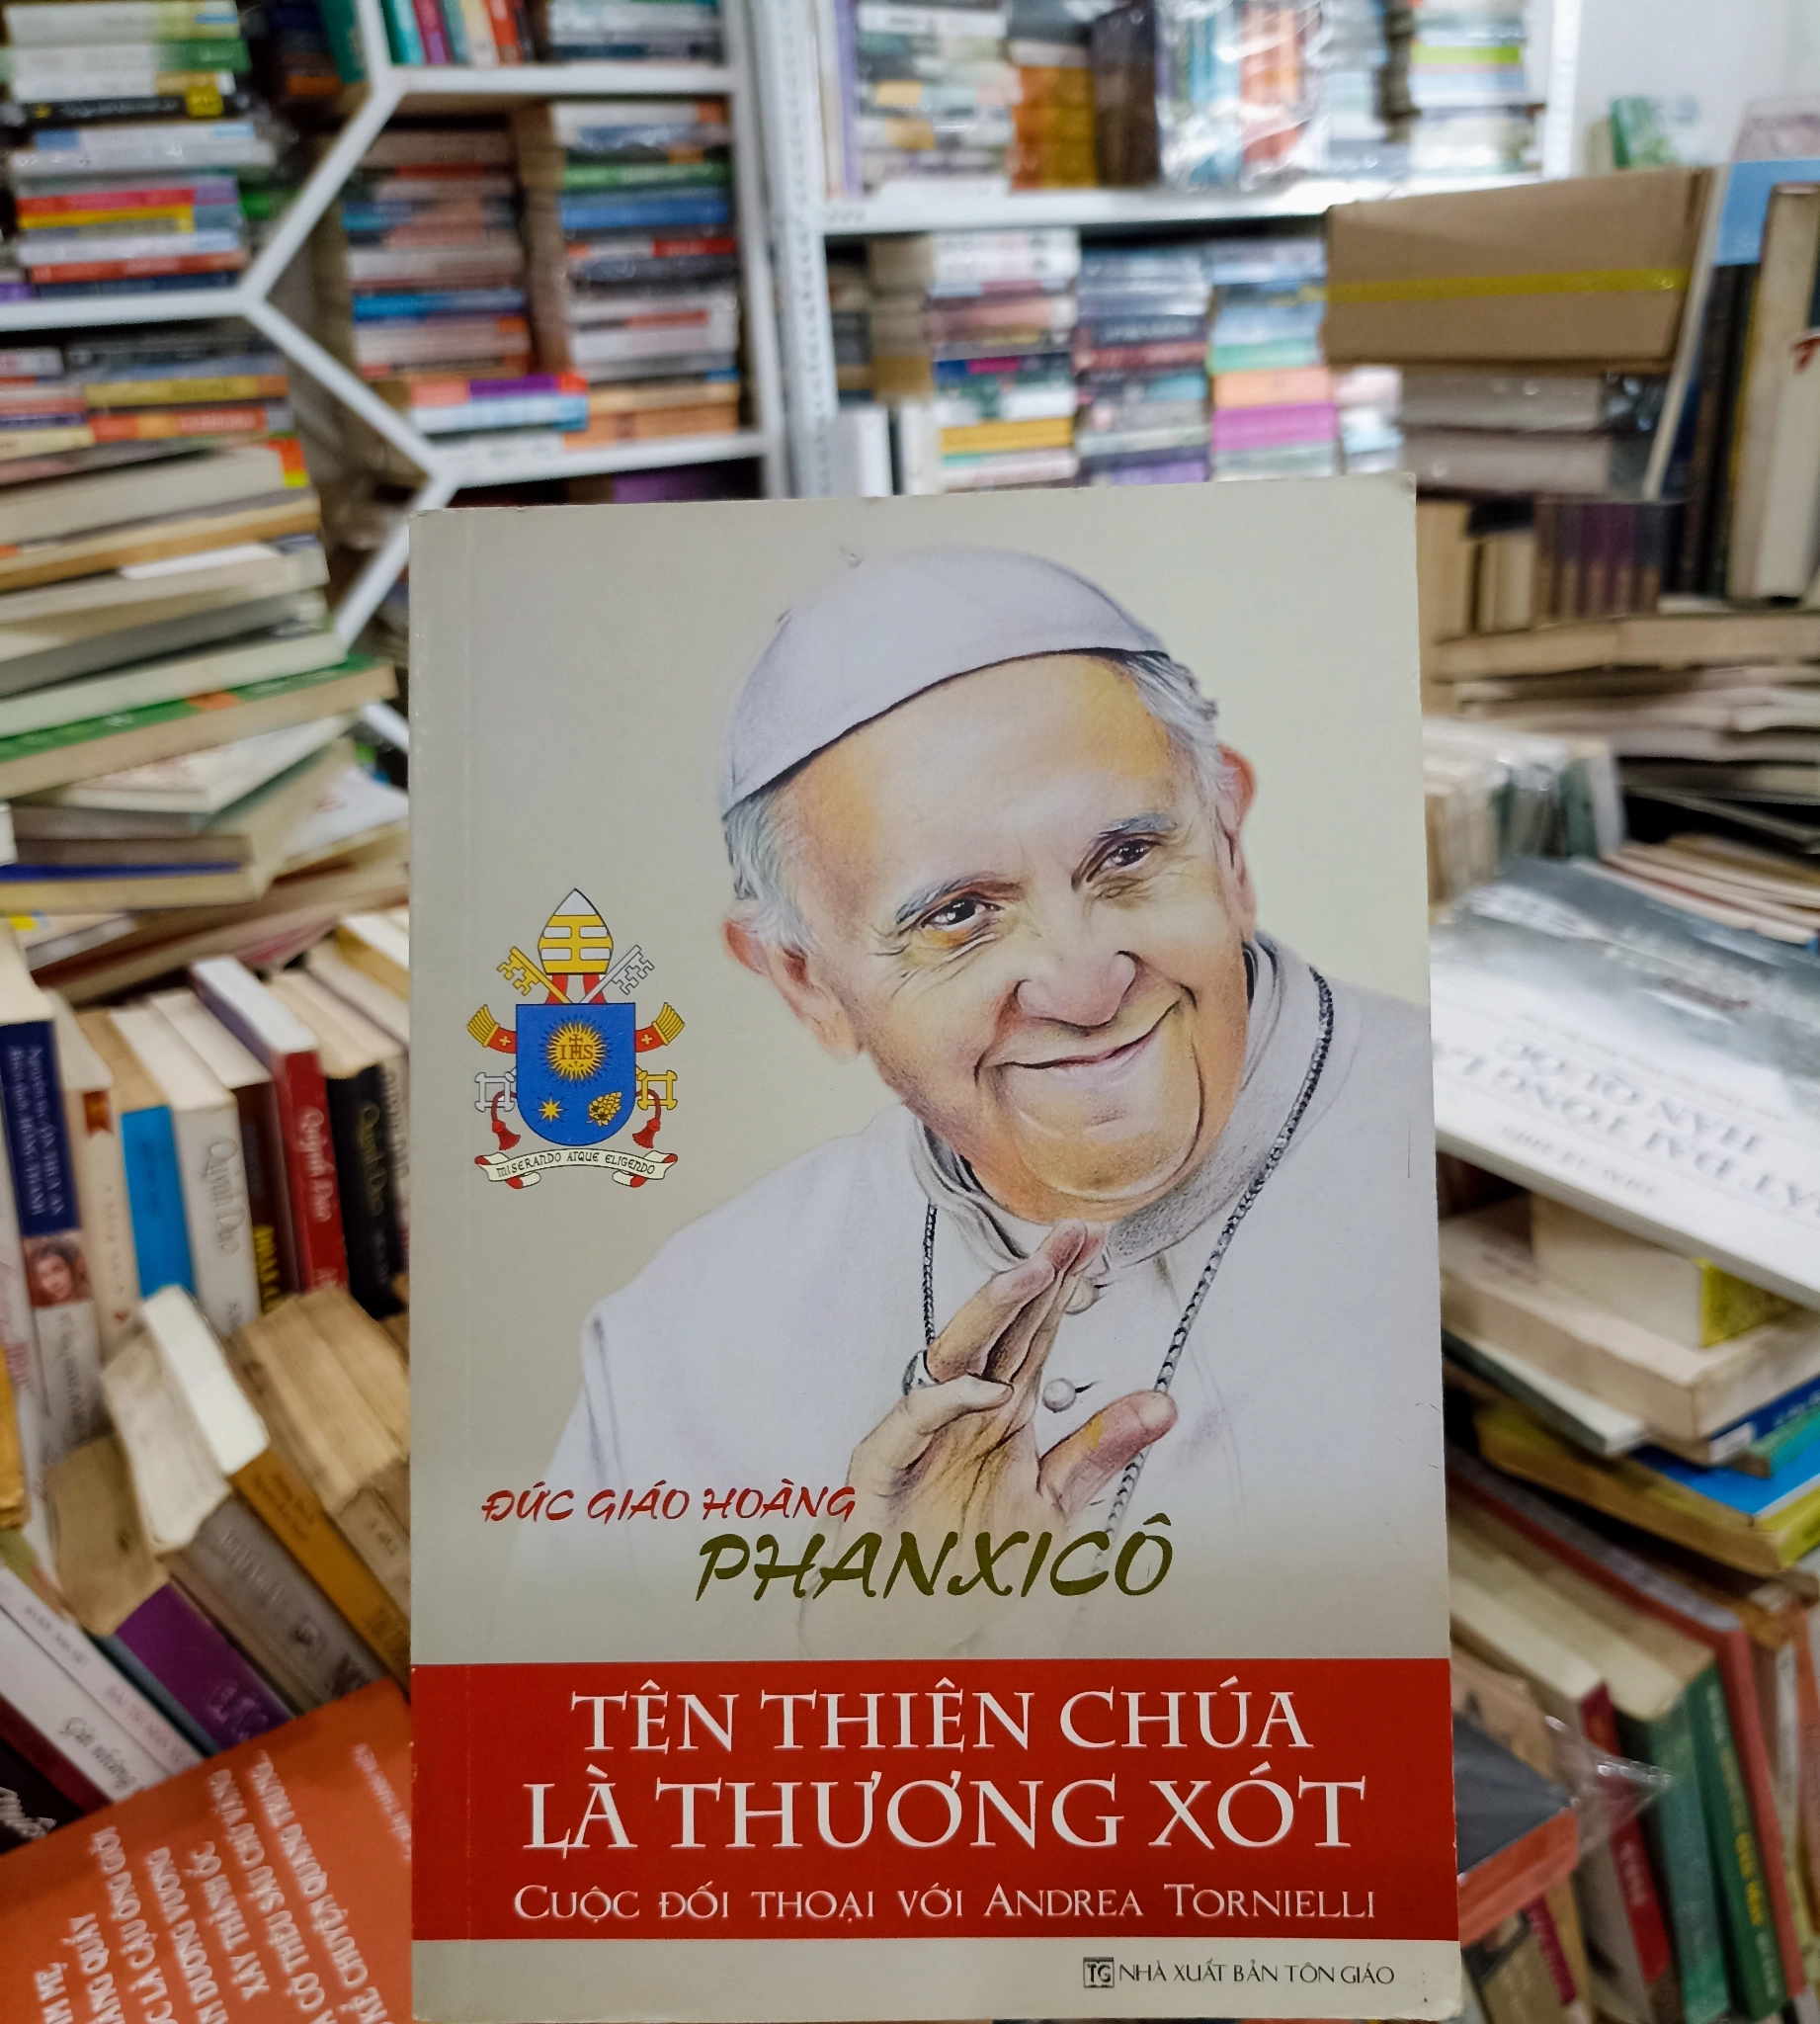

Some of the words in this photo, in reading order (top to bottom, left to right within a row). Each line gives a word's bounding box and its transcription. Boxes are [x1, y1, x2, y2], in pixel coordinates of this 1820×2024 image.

[496, 1152, 562, 1178] MISERANDO
[566, 1150, 600, 1163] ATQUE
[605, 1154, 656, 1175] ELIGENDO
[482, 1482, 573, 1521] ĐỨC
[588, 1480, 689, 1522] GIÁO
[703, 1479, 856, 1521] HOÀNG
[697, 1510, 1174, 1601] PHANXICÔ
[570, 1679, 739, 1754] TÊN
[761, 1677, 1034, 1752] THIÊN
[1060, 1676, 1314, 1748] CHÚA
[523, 1764, 638, 1859] LÀ
[656, 1770, 1124, 1848] THƯƠNG
[1148, 1761, 1366, 1849] XÓT
[280, 1823, 327, 1898] QUANG
[120, 1918, 158, 1970] CẬU
[1119, 1960, 1167, 1982] NHÀ
[1173, 1958, 1227, 1982] XUẤT
[1233, 1959, 1278, 1982] BẢN
[1284, 1962, 1335, 1983] TÔN
[1341, 1963, 1395, 1983] GIÁO
